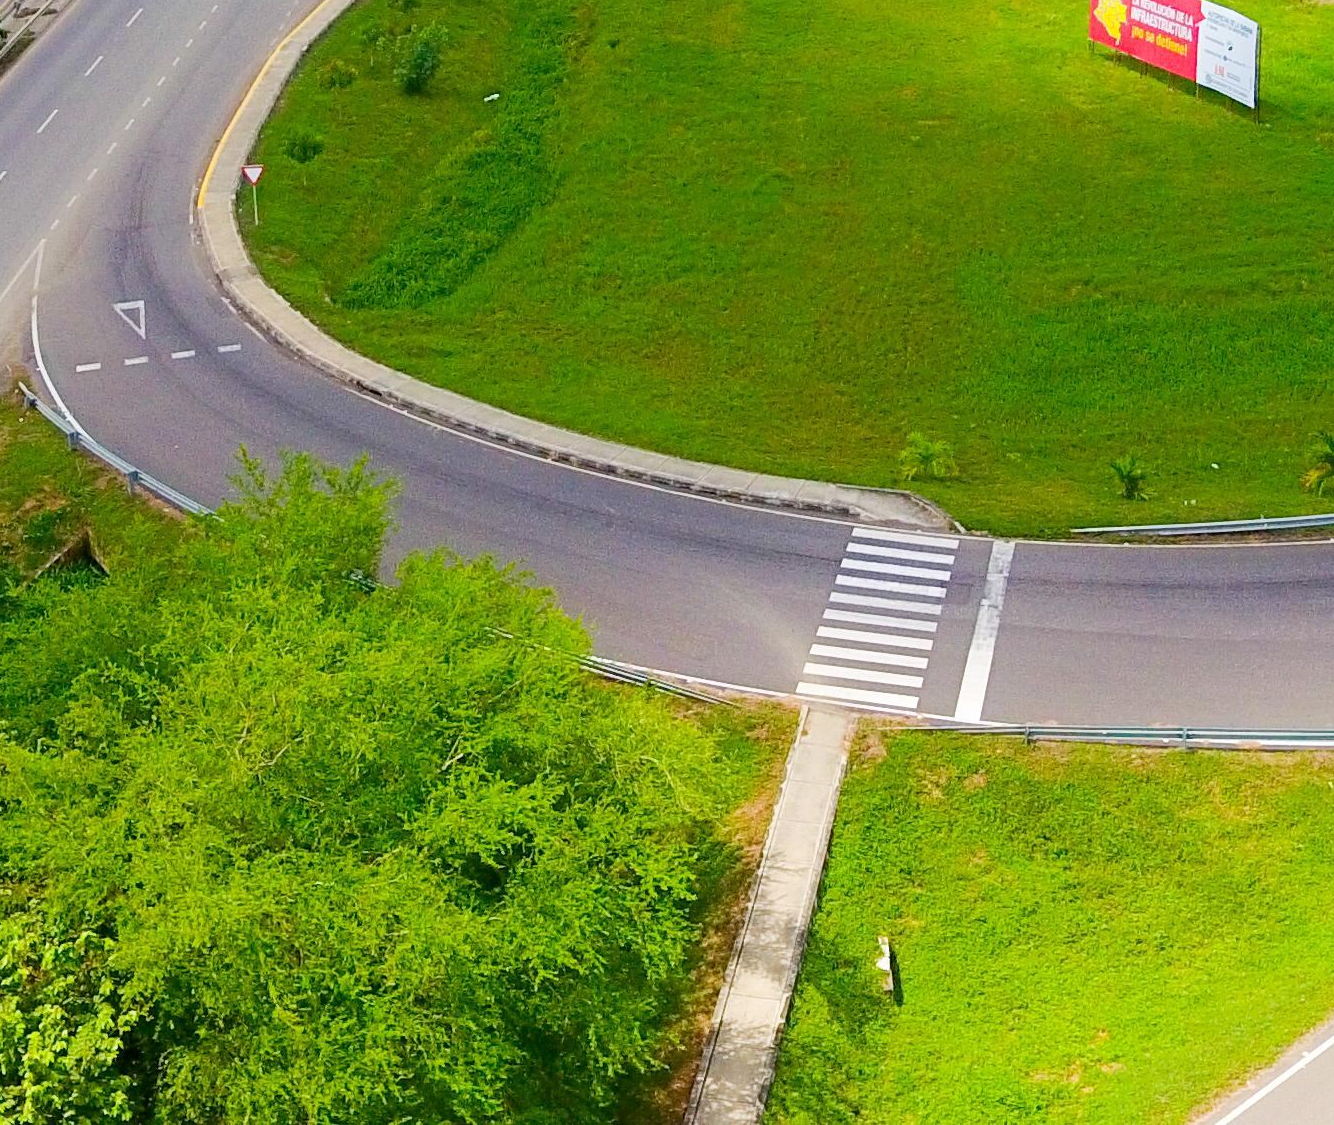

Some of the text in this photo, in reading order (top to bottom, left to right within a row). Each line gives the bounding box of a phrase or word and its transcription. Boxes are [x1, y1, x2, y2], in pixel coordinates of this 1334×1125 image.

[1131, 6, 1192, 42] INFRAESTRUCTURA
[1176, 10, 1185, 24] DE
[1185, 13, 1193, 27] LA
